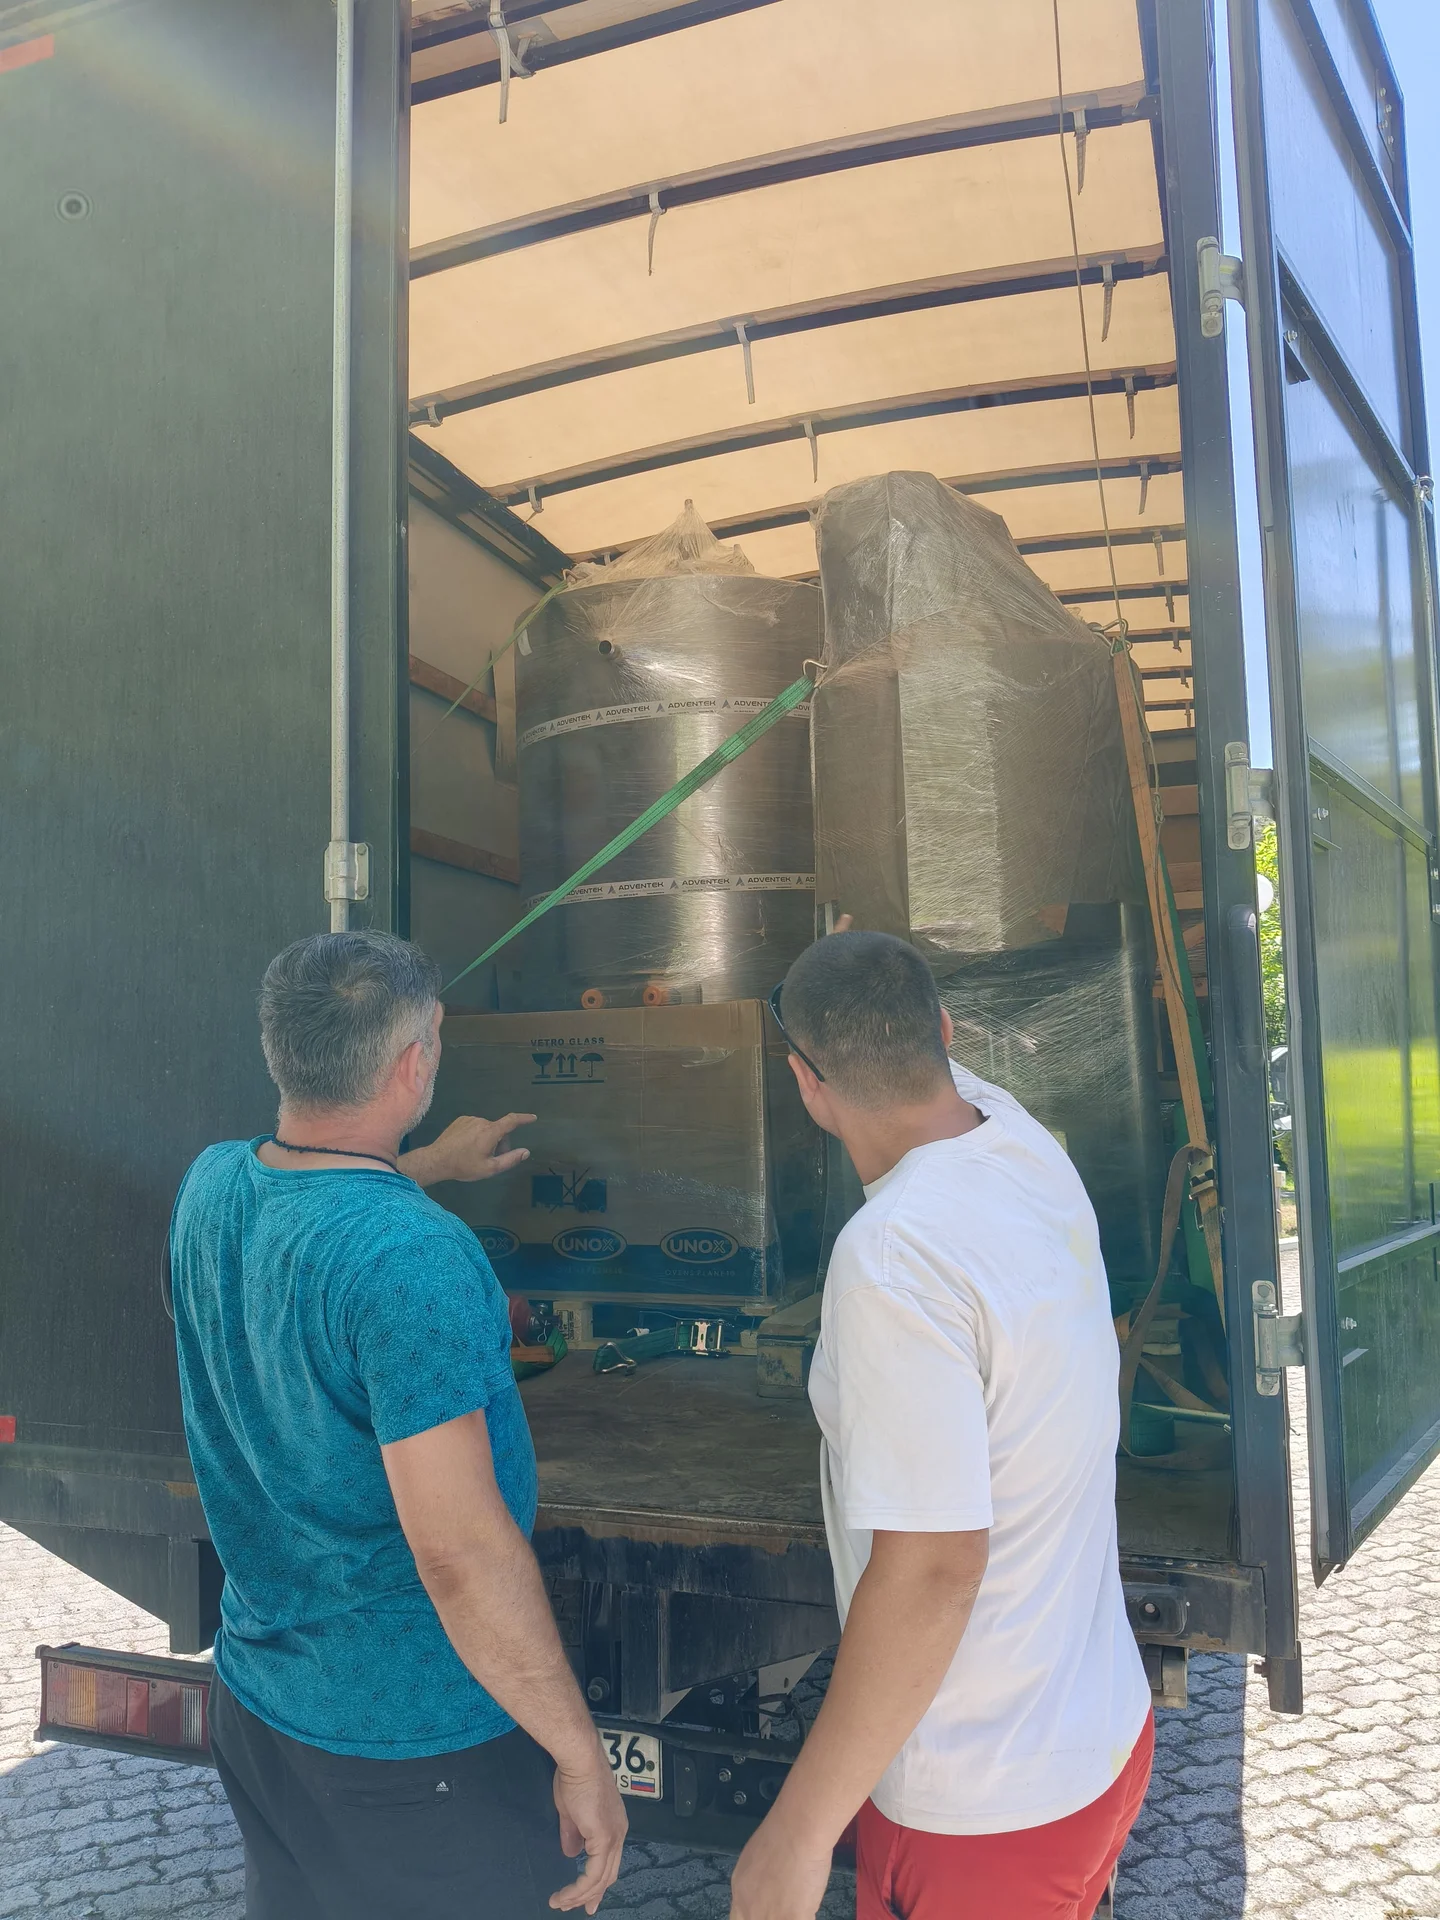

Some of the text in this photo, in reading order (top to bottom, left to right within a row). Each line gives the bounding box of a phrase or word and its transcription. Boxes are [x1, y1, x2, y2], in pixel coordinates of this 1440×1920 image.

[556, 713, 591, 727] ADVENTEK
[605, 705, 650, 717] ADVENTEK
[667, 700, 716, 709] ADVENTEK
[618, 881, 664, 891] ADVENTEK
[681, 878, 730, 886] ADVENTEK
[530, 1036, 605, 1047] VETRO GLASS
[560, 1236, 615, 1253] UNOX
[668, 1238, 727, 1254] UNOX
[603, 1732, 646, 1774] 36
[614, 1774, 629, 1788] S
